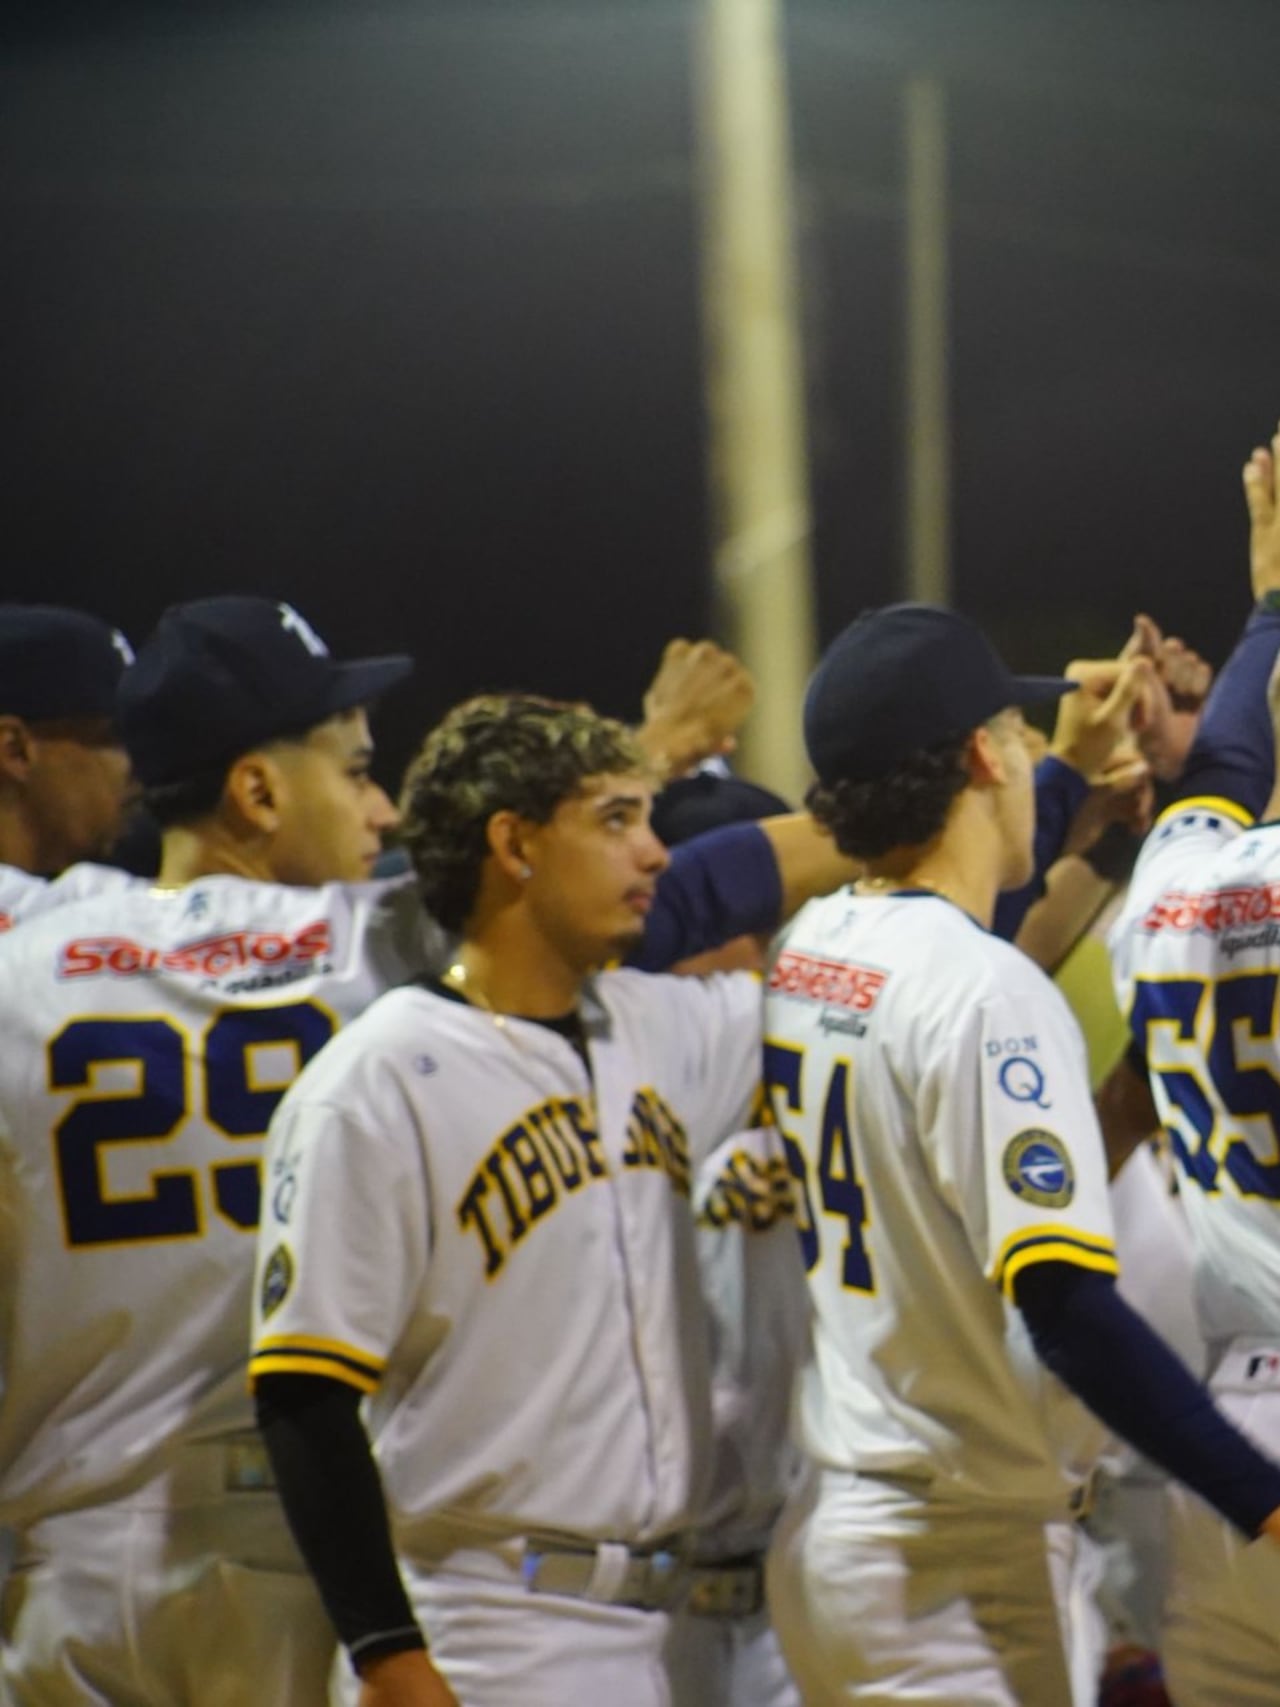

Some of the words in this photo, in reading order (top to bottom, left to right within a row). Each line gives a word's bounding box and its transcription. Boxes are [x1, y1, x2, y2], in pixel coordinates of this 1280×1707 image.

[985, 1035, 1037, 1058] DON
[998, 1056, 1052, 1110] Q
[46, 996, 342, 1254] 29
